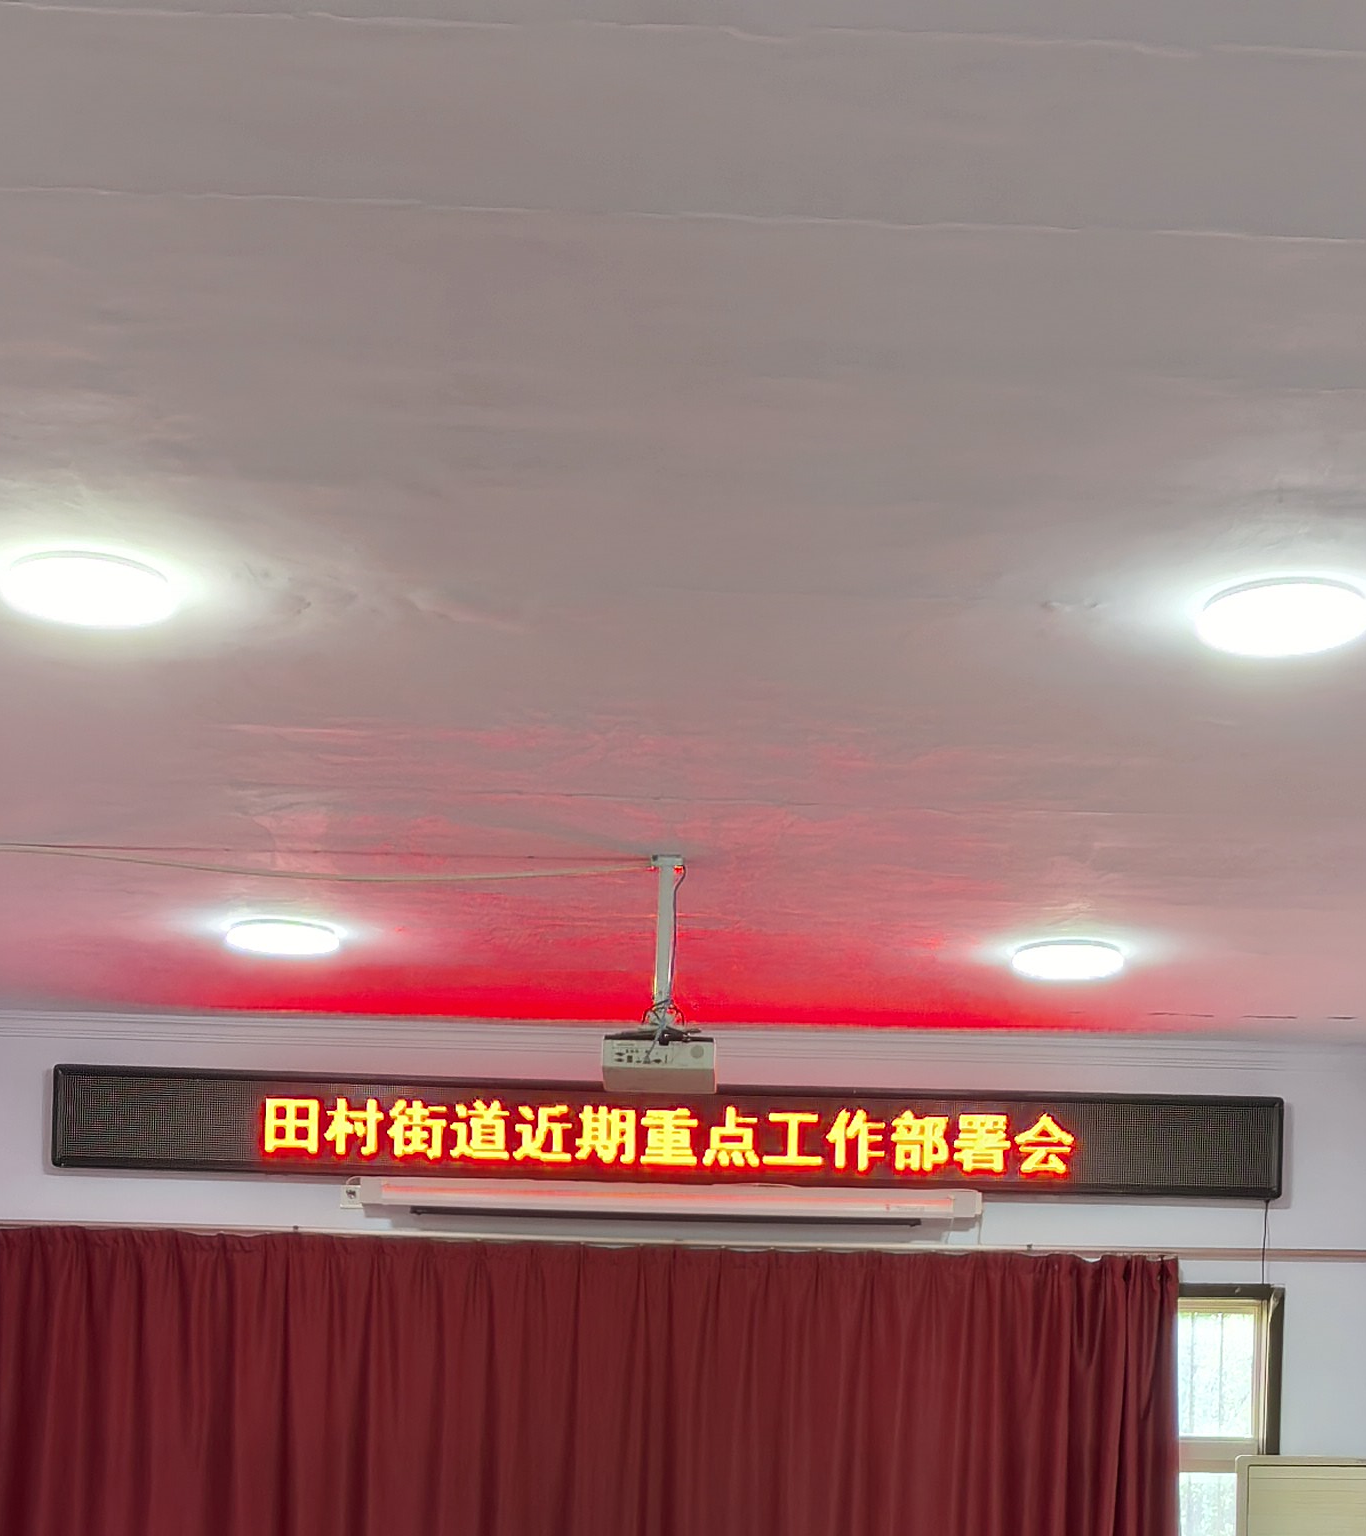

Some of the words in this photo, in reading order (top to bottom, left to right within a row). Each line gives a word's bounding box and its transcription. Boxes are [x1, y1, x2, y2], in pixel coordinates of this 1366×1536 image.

[263, 1097, 1076, 1174] 田村街道近期重点工作部署会
